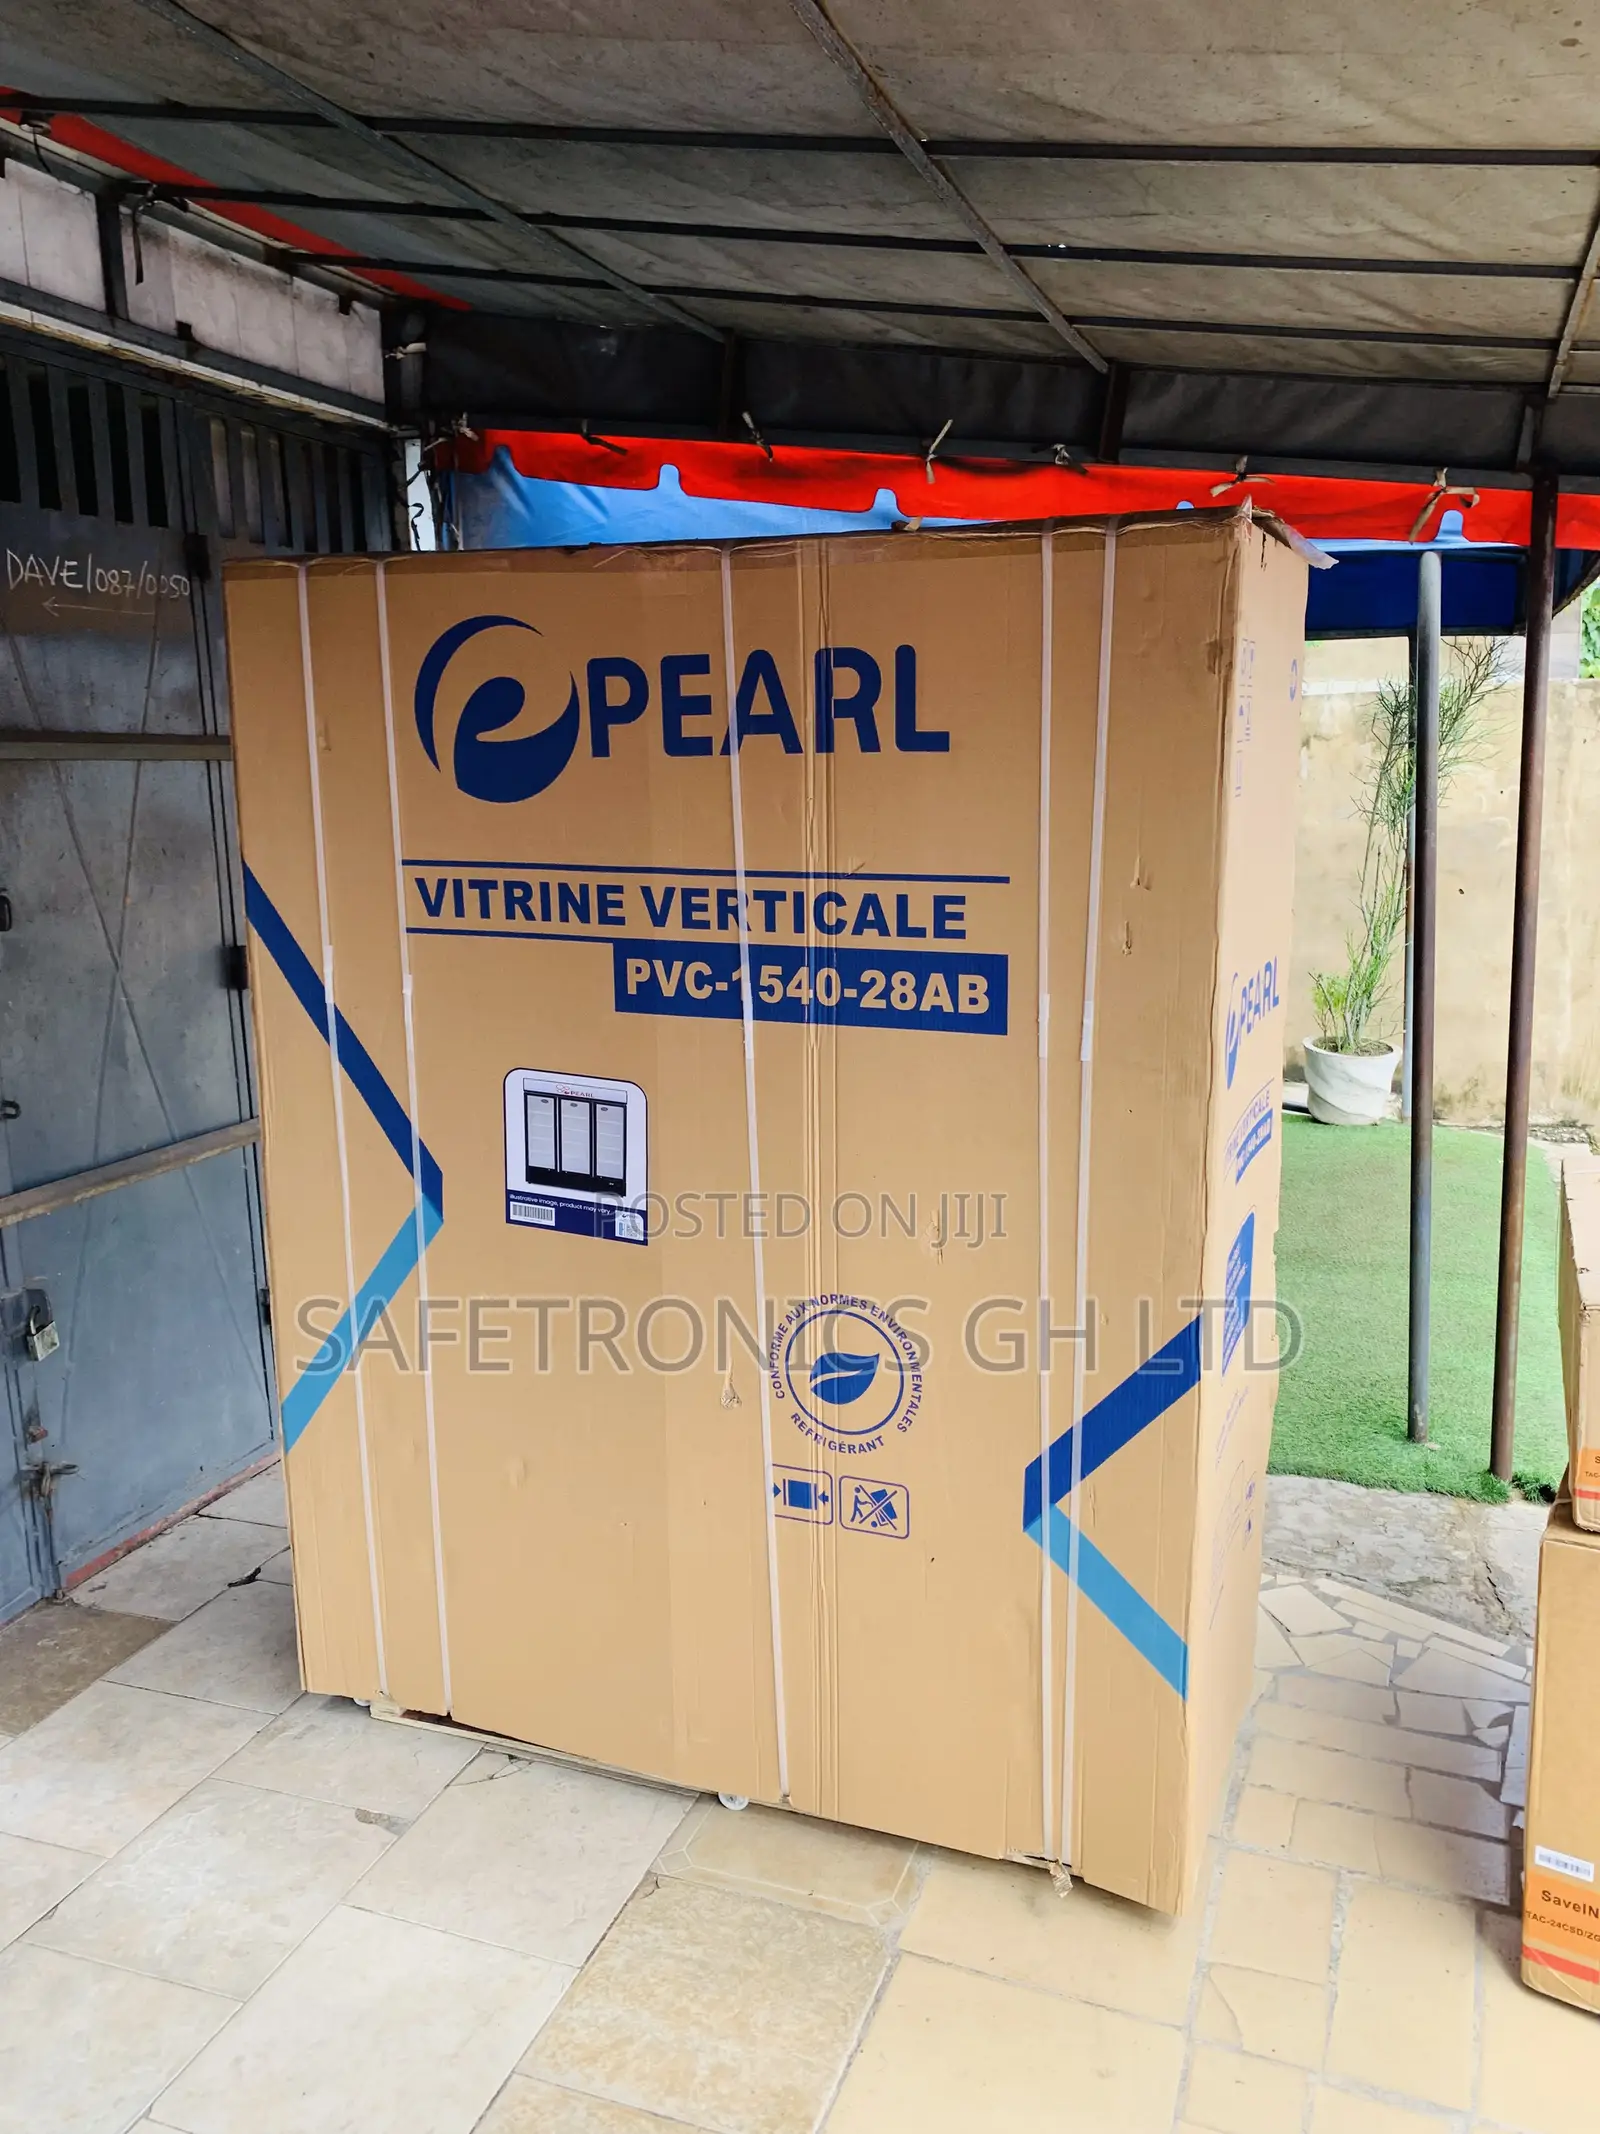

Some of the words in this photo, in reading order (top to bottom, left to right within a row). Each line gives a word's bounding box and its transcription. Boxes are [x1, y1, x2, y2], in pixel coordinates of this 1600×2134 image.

[587, 644, 950, 758] PEARL
[414, 877, 627, 927] VITRINE
[640, 886, 968, 940] VERTICALE
[625, 958, 990, 1015] PVC-1540-28AB
[1238, 956, 1280, 1045] PEARL
[560, 1202, 583, 1210] product
[769, 1322, 789, 1400] CONFORME
[785, 1302, 809, 1327] AUX
[811, 1293, 868, 1310] NORMES
[870, 1305, 923, 1434] ENVIRONMENTALES
[790, 1412, 885, 1455] REFRIGÉRANT
